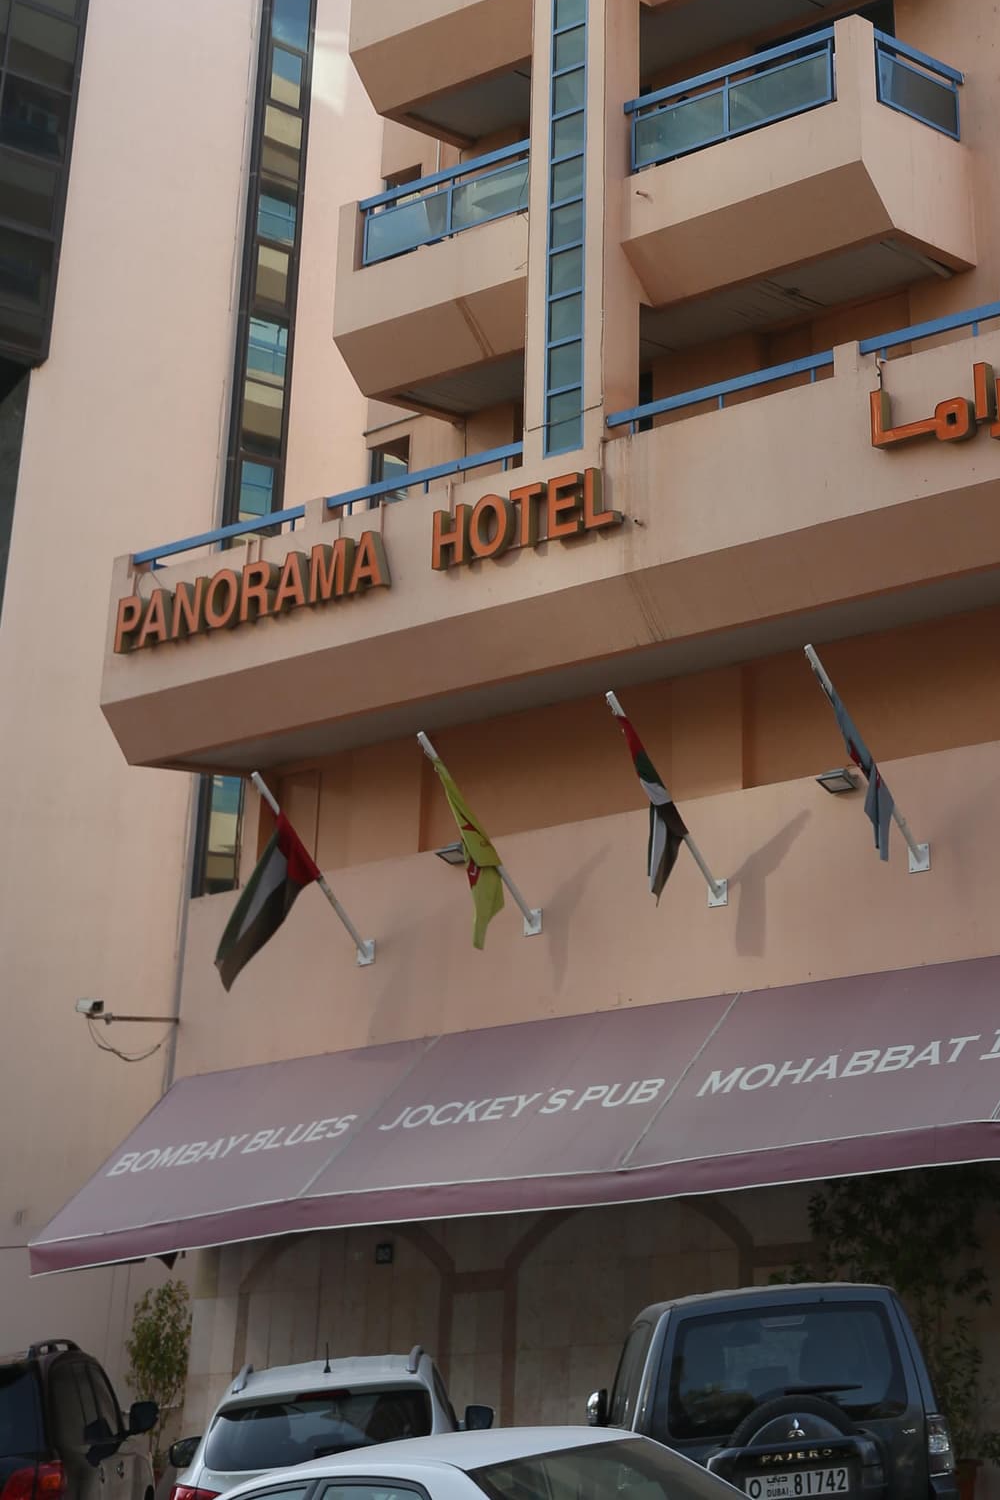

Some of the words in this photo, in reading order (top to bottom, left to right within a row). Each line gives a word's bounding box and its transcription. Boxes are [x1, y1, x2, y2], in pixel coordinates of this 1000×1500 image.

[113, 530, 391, 654] PANORAMA
[432, 467, 624, 571] HOTEL
[697, 1035, 980, 1098] MOHABBAT
[378, 1087, 573, 1132] JOCKEY'S
[573, 1077, 666, 1112] PUB
[106, 1133, 246, 1177] BOMBAY
[241, 1114, 358, 1154] BLUES
[760, 1448, 832, 1464] PAJERO
[793, 1469, 847, 1495] 81742
[766, 1486, 789, 1498] DUBAI
